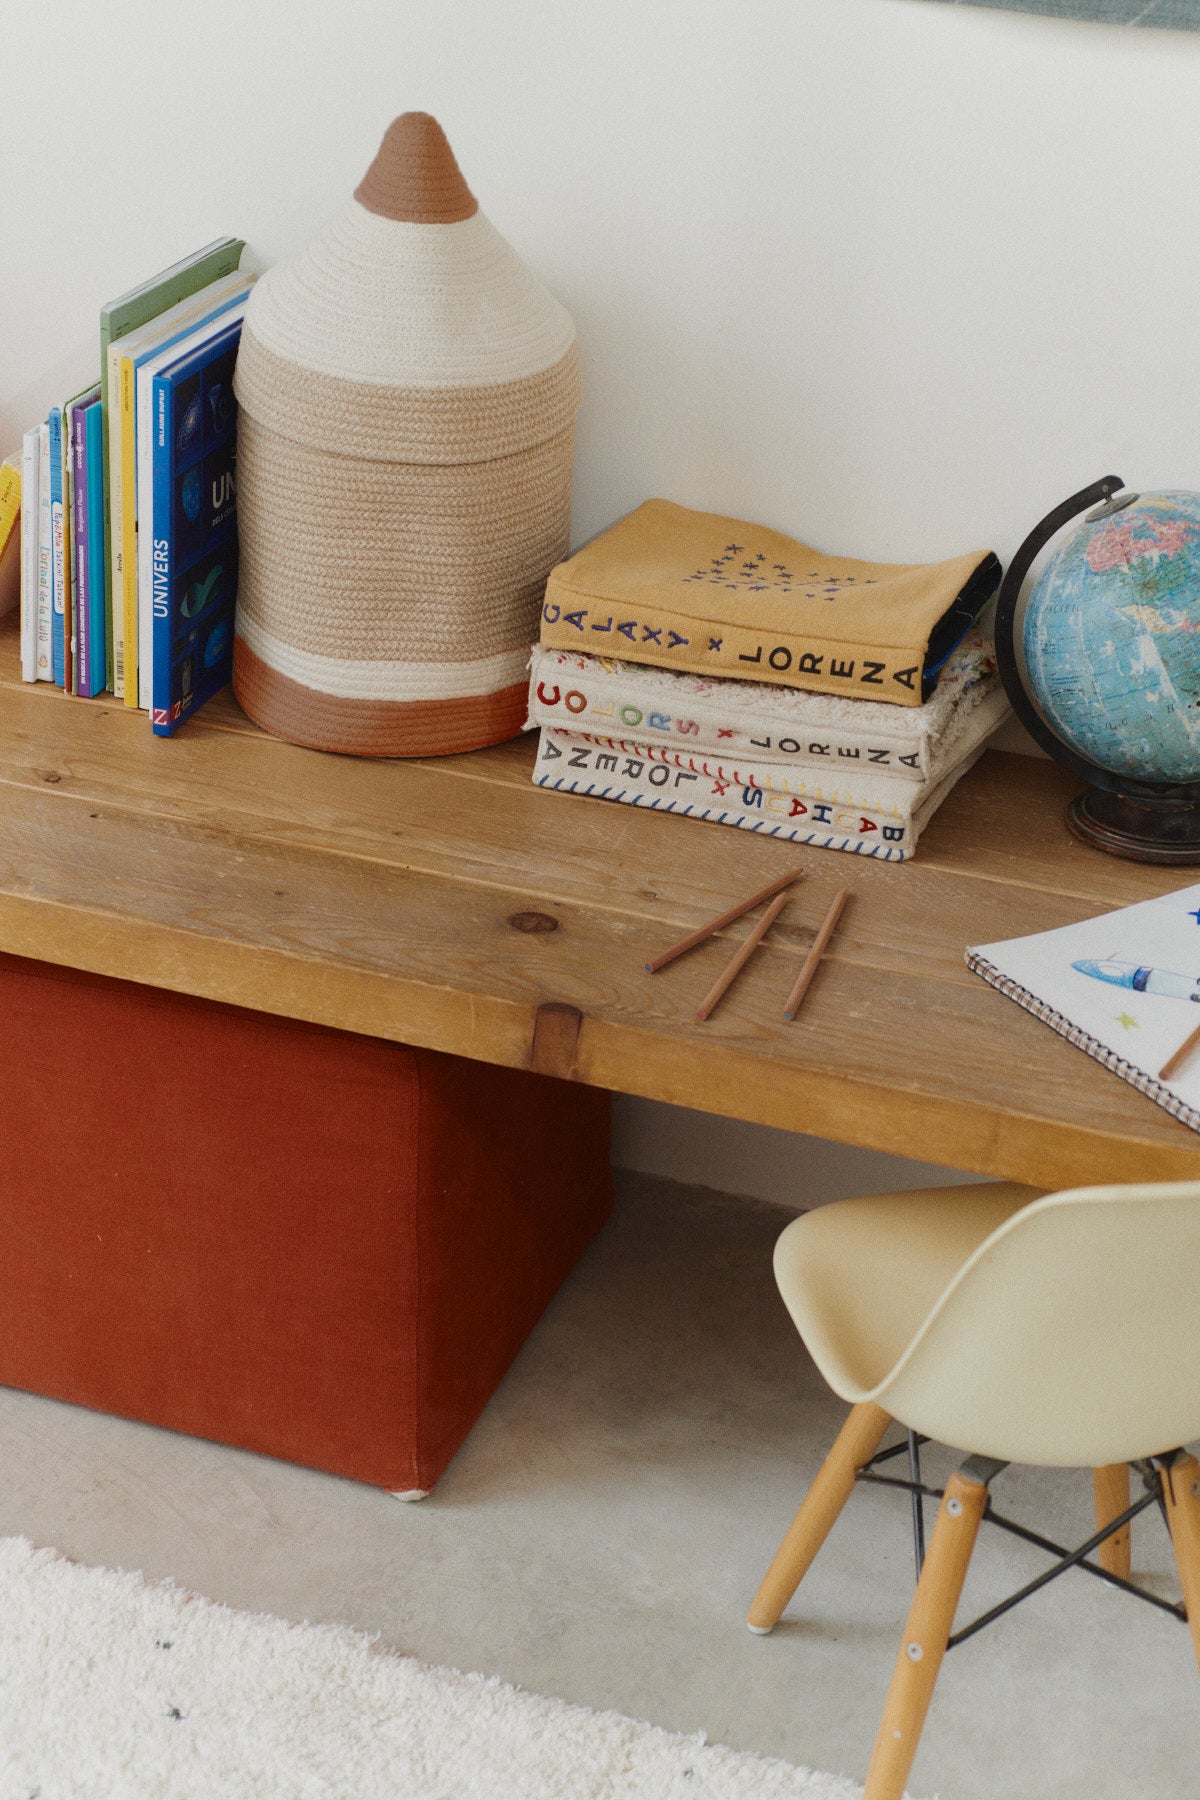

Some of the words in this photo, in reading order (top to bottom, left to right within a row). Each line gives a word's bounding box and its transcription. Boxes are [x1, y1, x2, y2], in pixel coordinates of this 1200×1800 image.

[153, 539, 169, 618] UNIVERS
[542, 602, 690, 649] GALAXY
[738, 645, 920, 691] LORENA
[154, 708, 167, 726] Z
[174, 700, 181, 719] Z
[536, 680, 700, 736] COLORS
[749, 736, 921, 769] LORENA
[542, 739, 698, 789] LORENA
[742, 785, 905, 842] BAUHAUS
